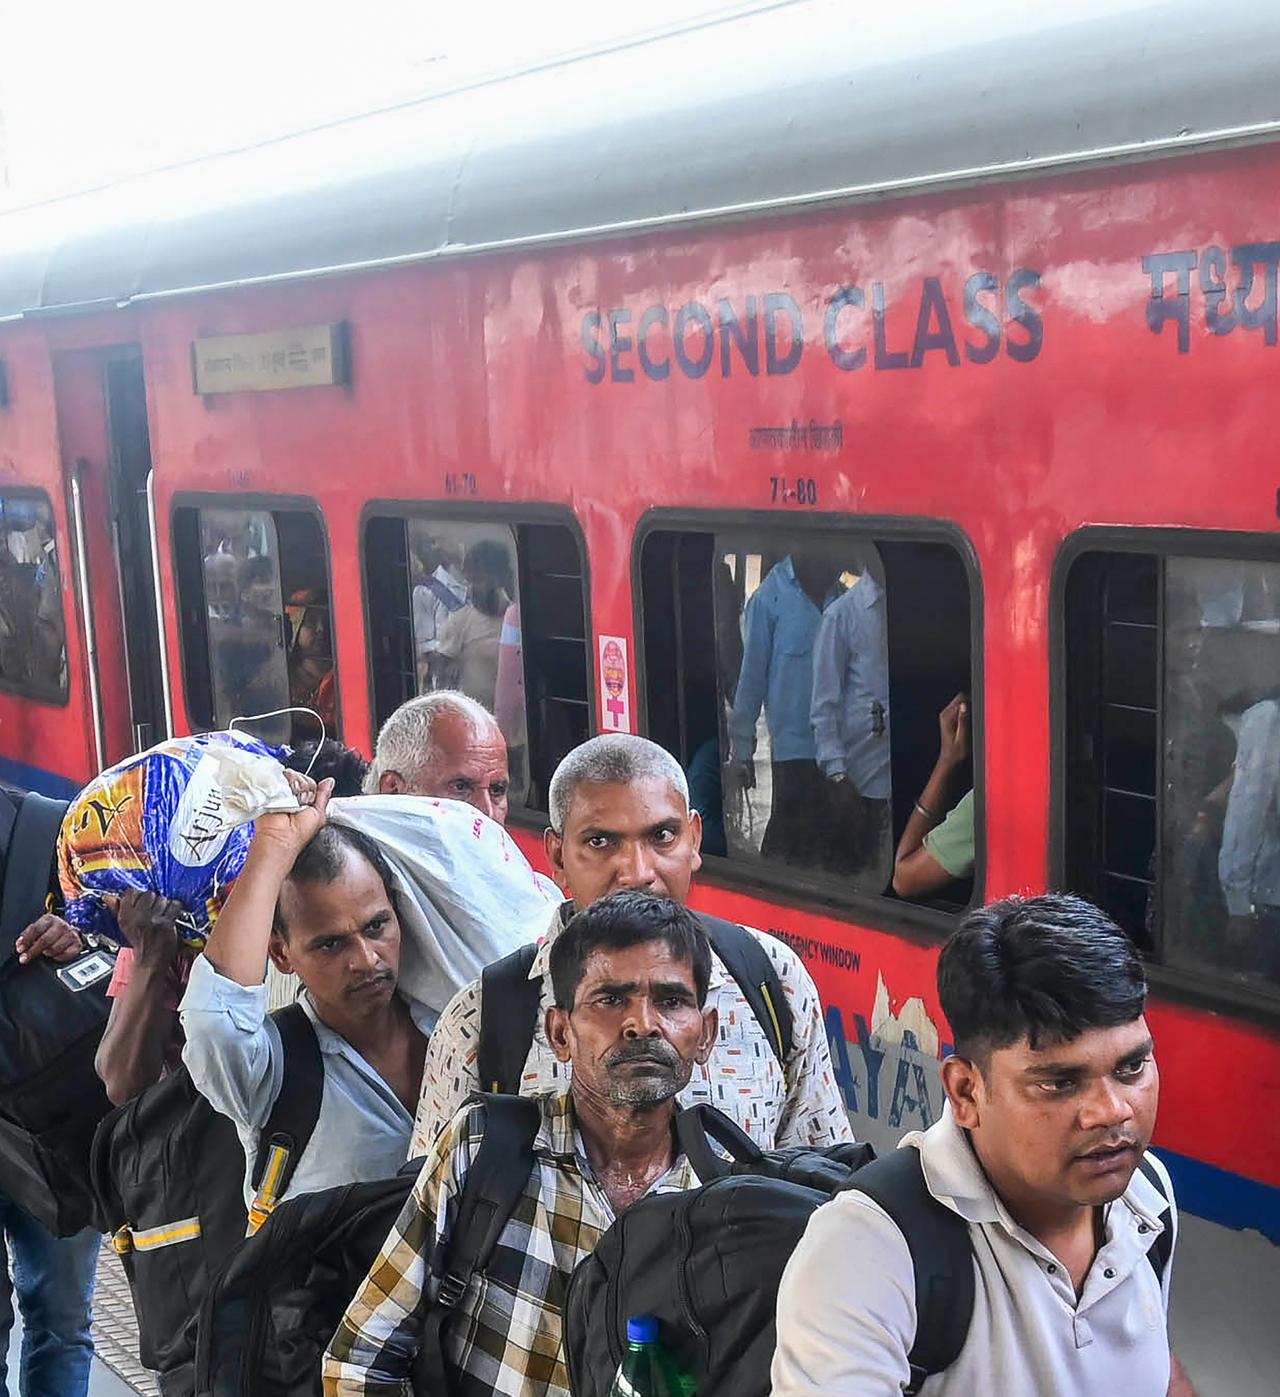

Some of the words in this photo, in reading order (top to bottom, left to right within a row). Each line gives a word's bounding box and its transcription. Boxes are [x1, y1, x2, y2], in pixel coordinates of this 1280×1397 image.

[581, 292, 804, 385] SECOND
[825, 268, 1044, 371] CLASS
[770, 477, 817, 505] 71-80
[180, 789, 222, 861] Arjun
[820, 942, 861, 972] WINDOW
